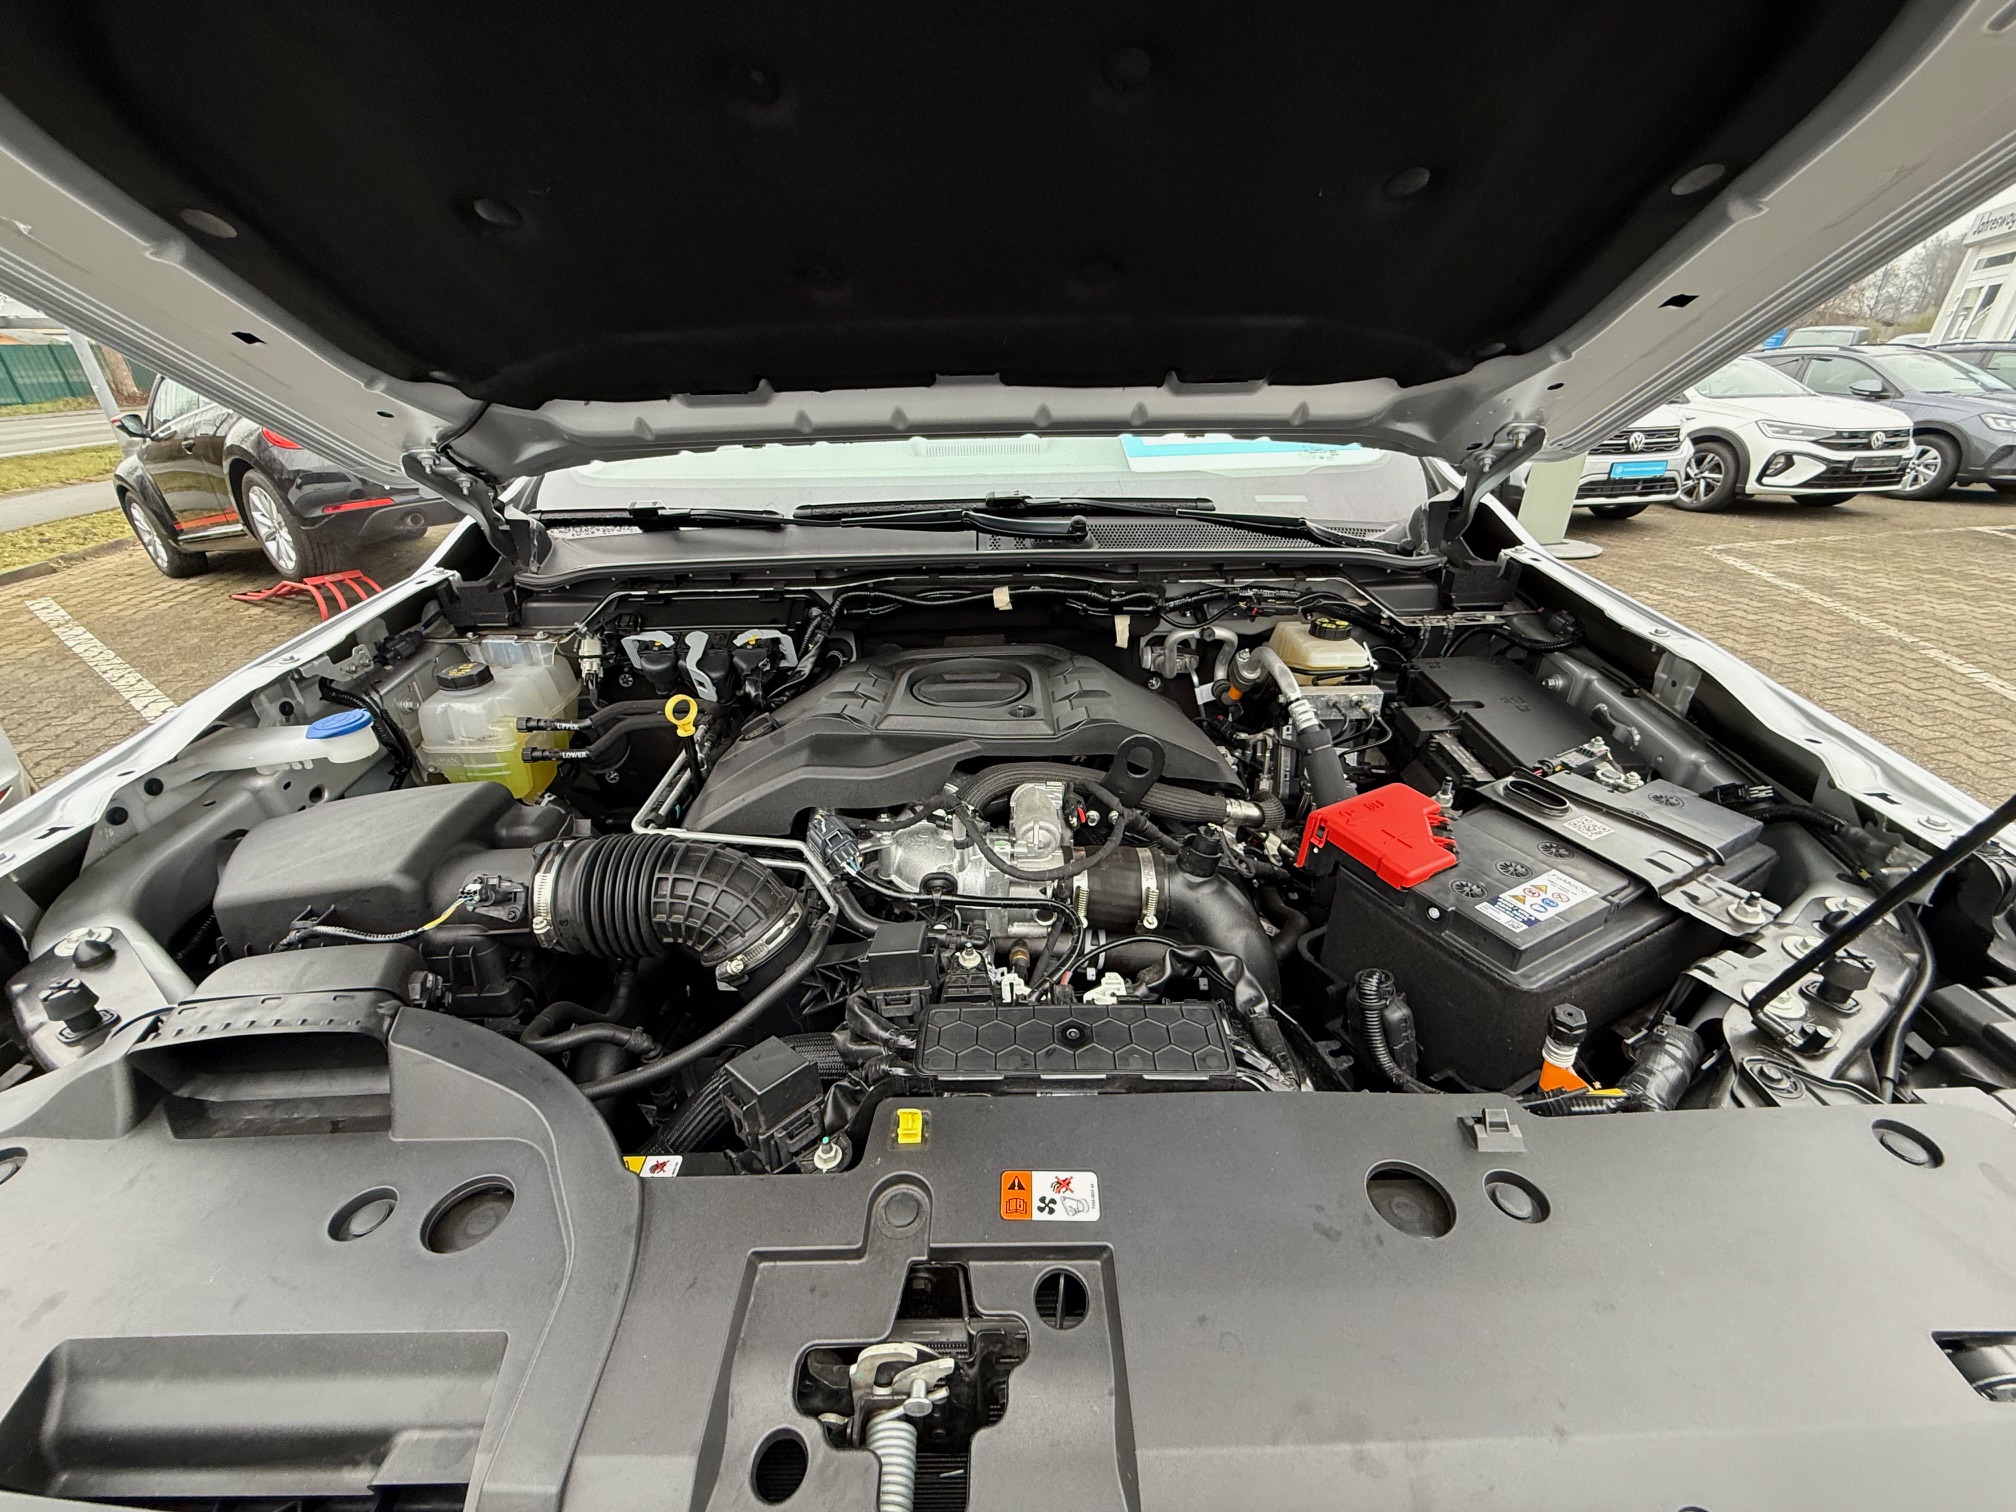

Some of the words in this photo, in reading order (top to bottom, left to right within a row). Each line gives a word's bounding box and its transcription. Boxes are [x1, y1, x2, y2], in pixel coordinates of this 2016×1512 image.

[556, 722, 580, 731] UPPER
[561, 751, 588, 759] LOWER
[1550, 873, 1588, 894] FoMoCo
